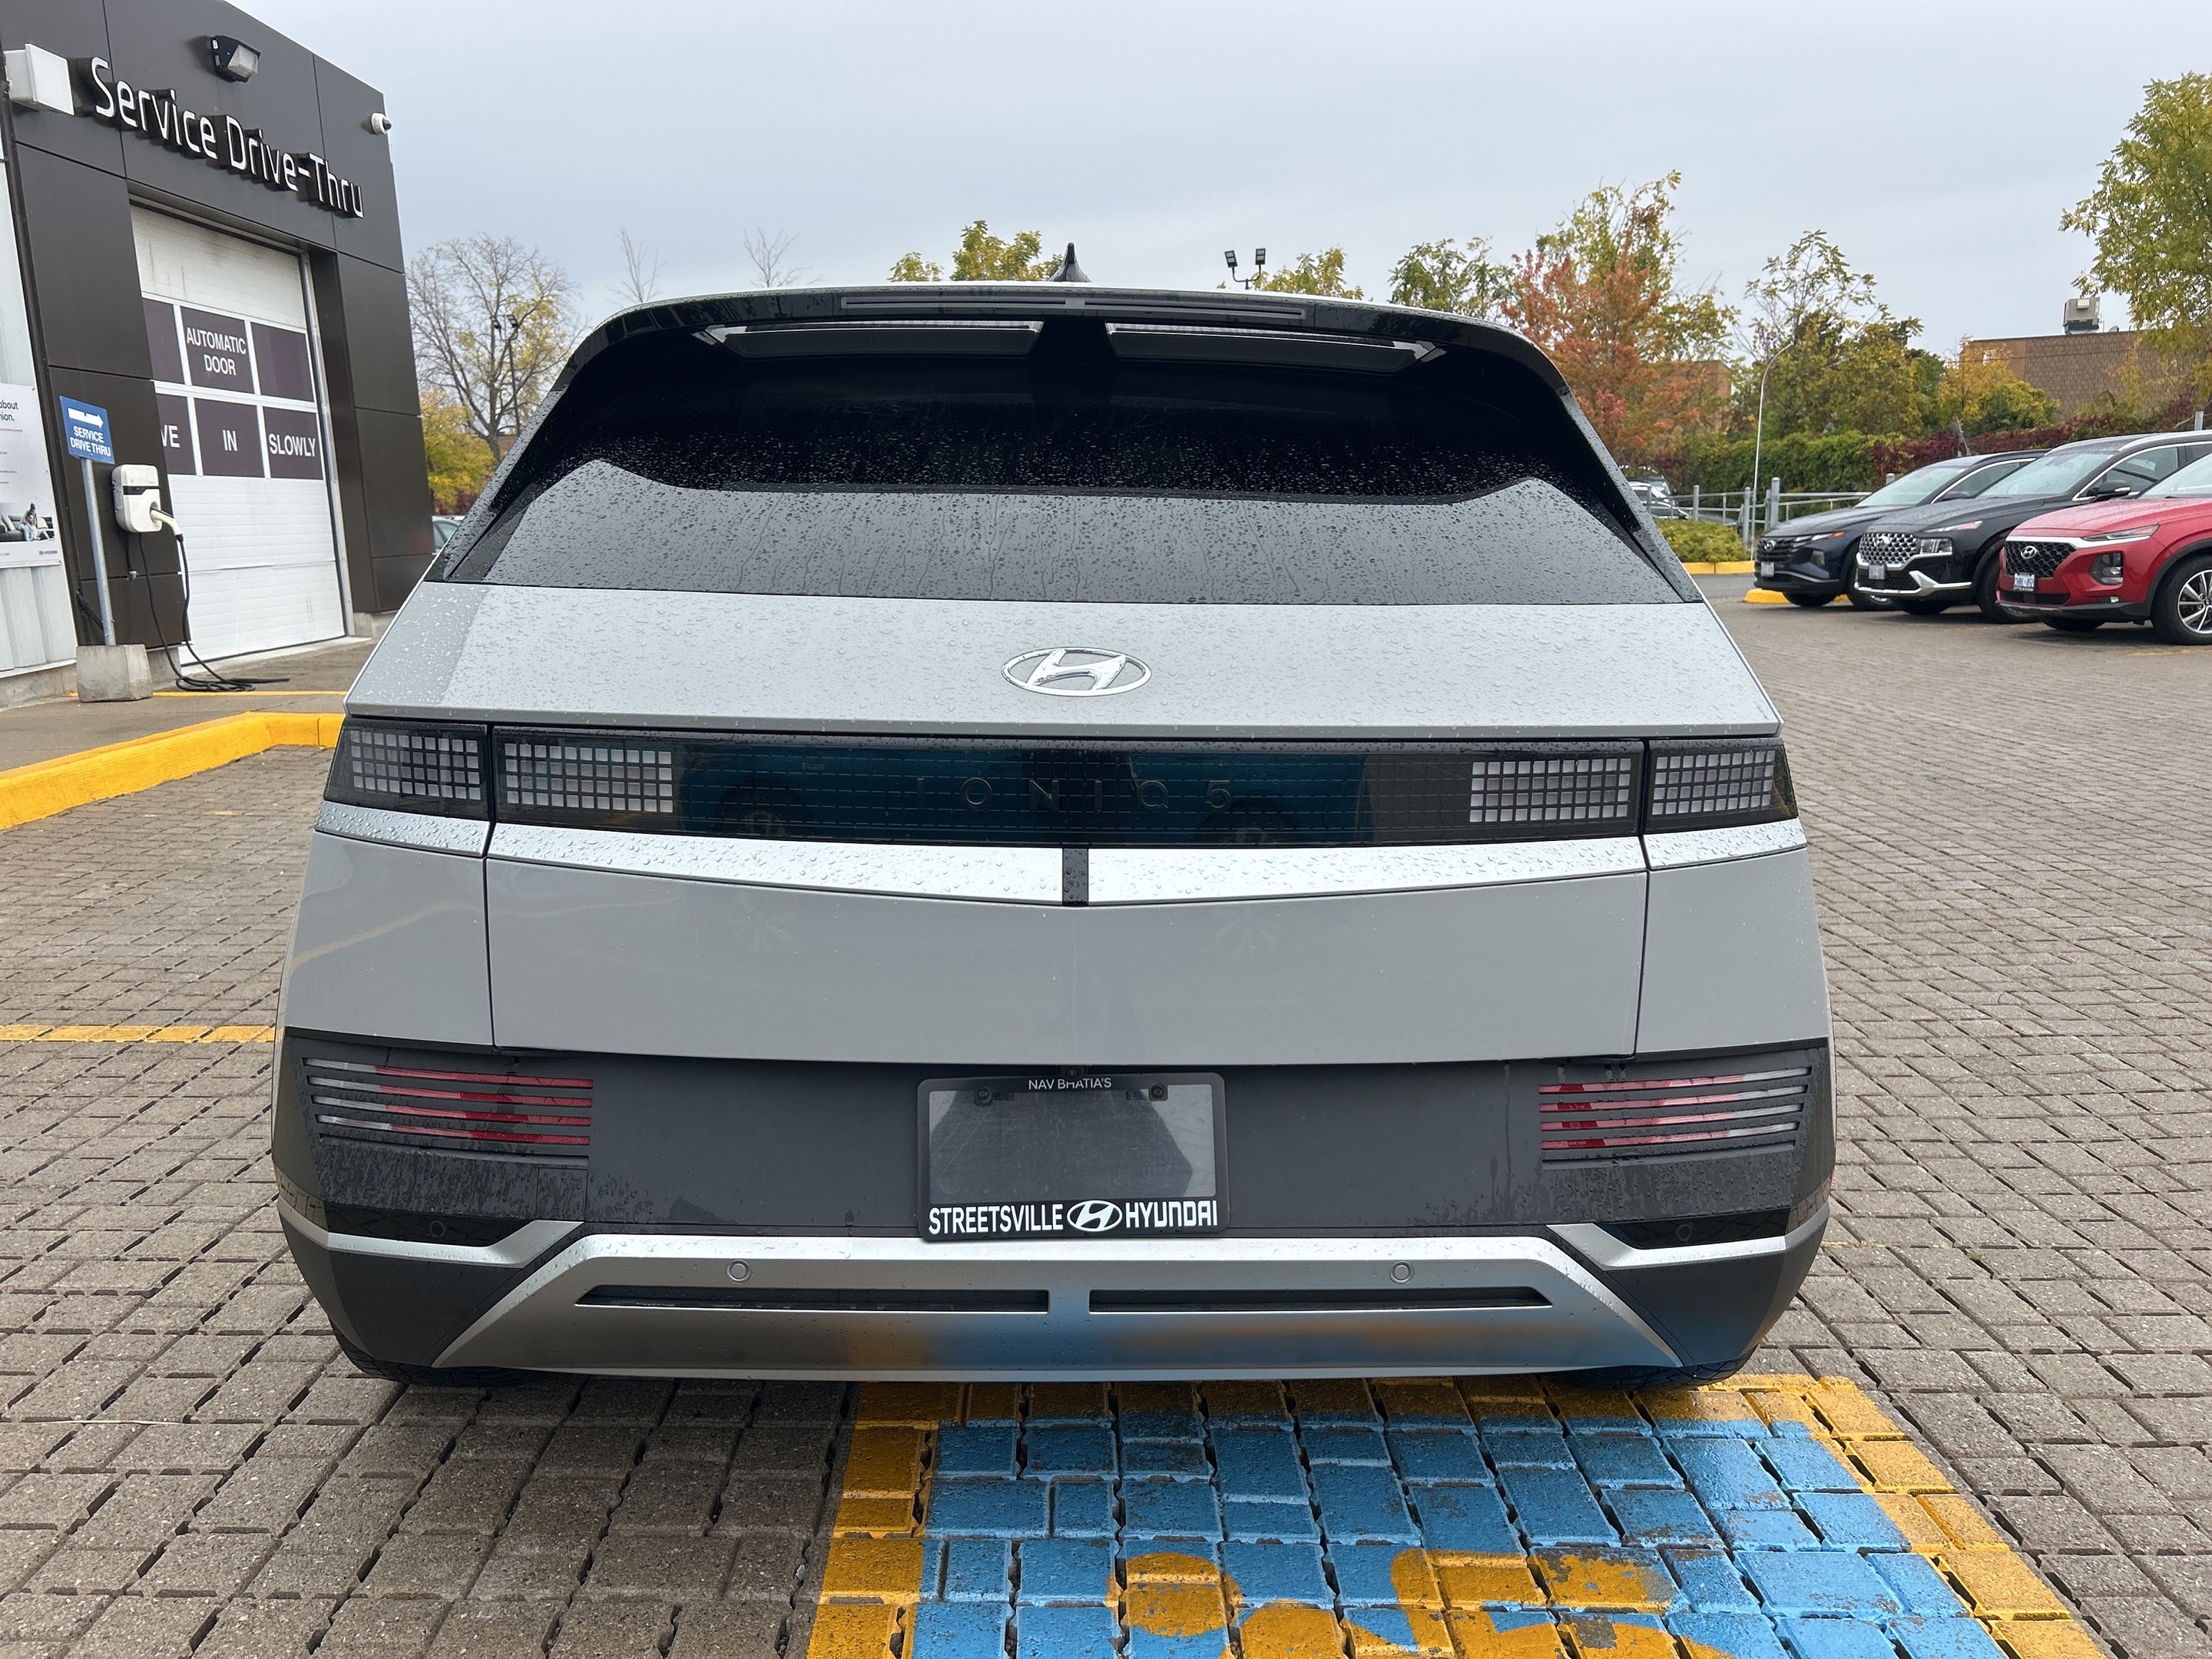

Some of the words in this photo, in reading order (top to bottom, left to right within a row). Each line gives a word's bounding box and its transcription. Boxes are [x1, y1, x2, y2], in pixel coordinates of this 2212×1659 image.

[91, 56, 218, 160] Service
[226, 114, 364, 218] Drive-Thru
[187, 327, 247, 355] AUTOMATIC
[204, 354, 237, 376] DOOR
[70, 437, 91, 452] DRIVE
[91, 442, 111, 457] THRU
[73, 426, 104, 443] SERVICE
[222, 429, 238, 452] IN
[269, 433, 316, 457] SLOWLY
[1028, 1079, 1055, 1090] NAV
[1058, 1077, 1112, 1089] BHATIA'S
[928, 1204, 1064, 1235] STREETSVILLE
[1126, 1200, 1218, 1229] HYUNDAI
